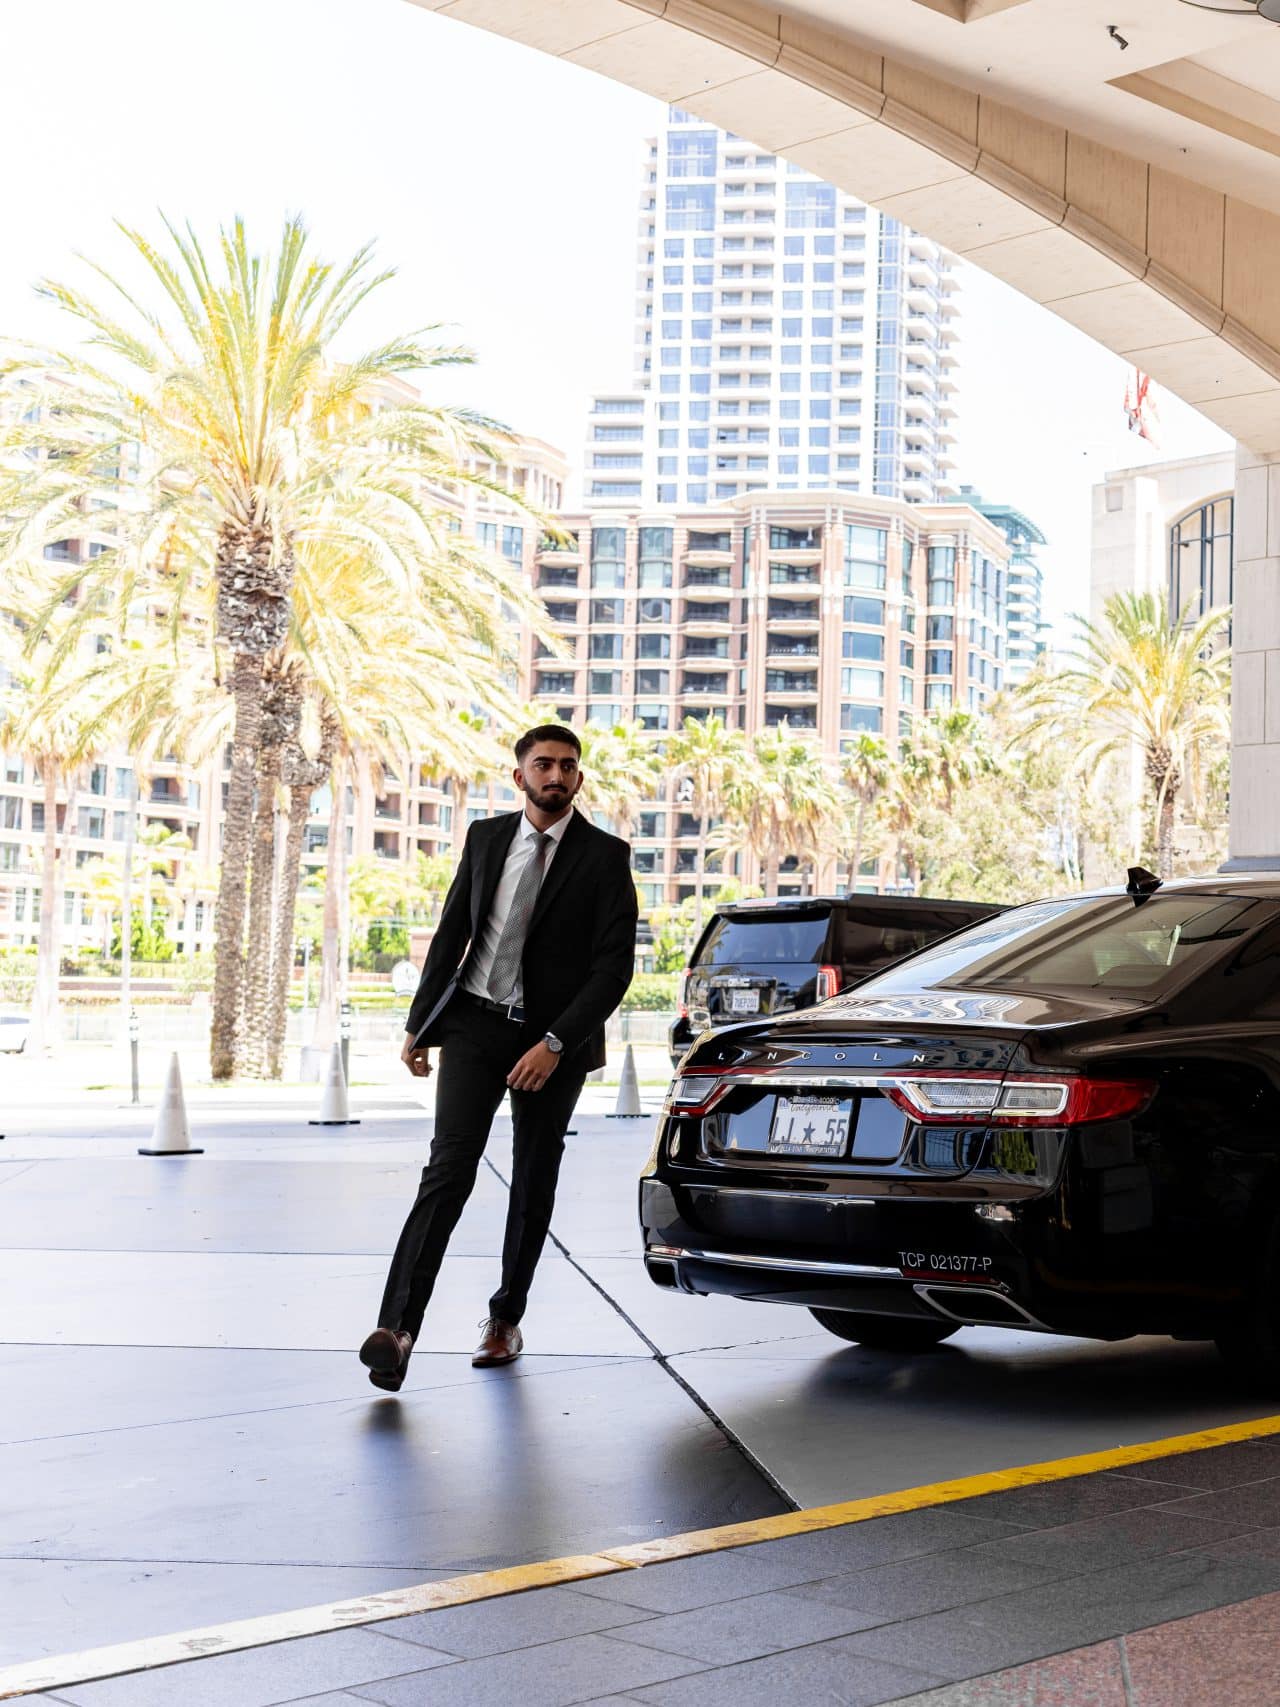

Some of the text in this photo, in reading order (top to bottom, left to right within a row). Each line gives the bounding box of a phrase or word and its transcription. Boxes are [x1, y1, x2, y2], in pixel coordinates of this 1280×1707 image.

[717, 1051, 925, 1063] LINCOLN
[897, 1251, 992, 1271] TCP 021377-P
